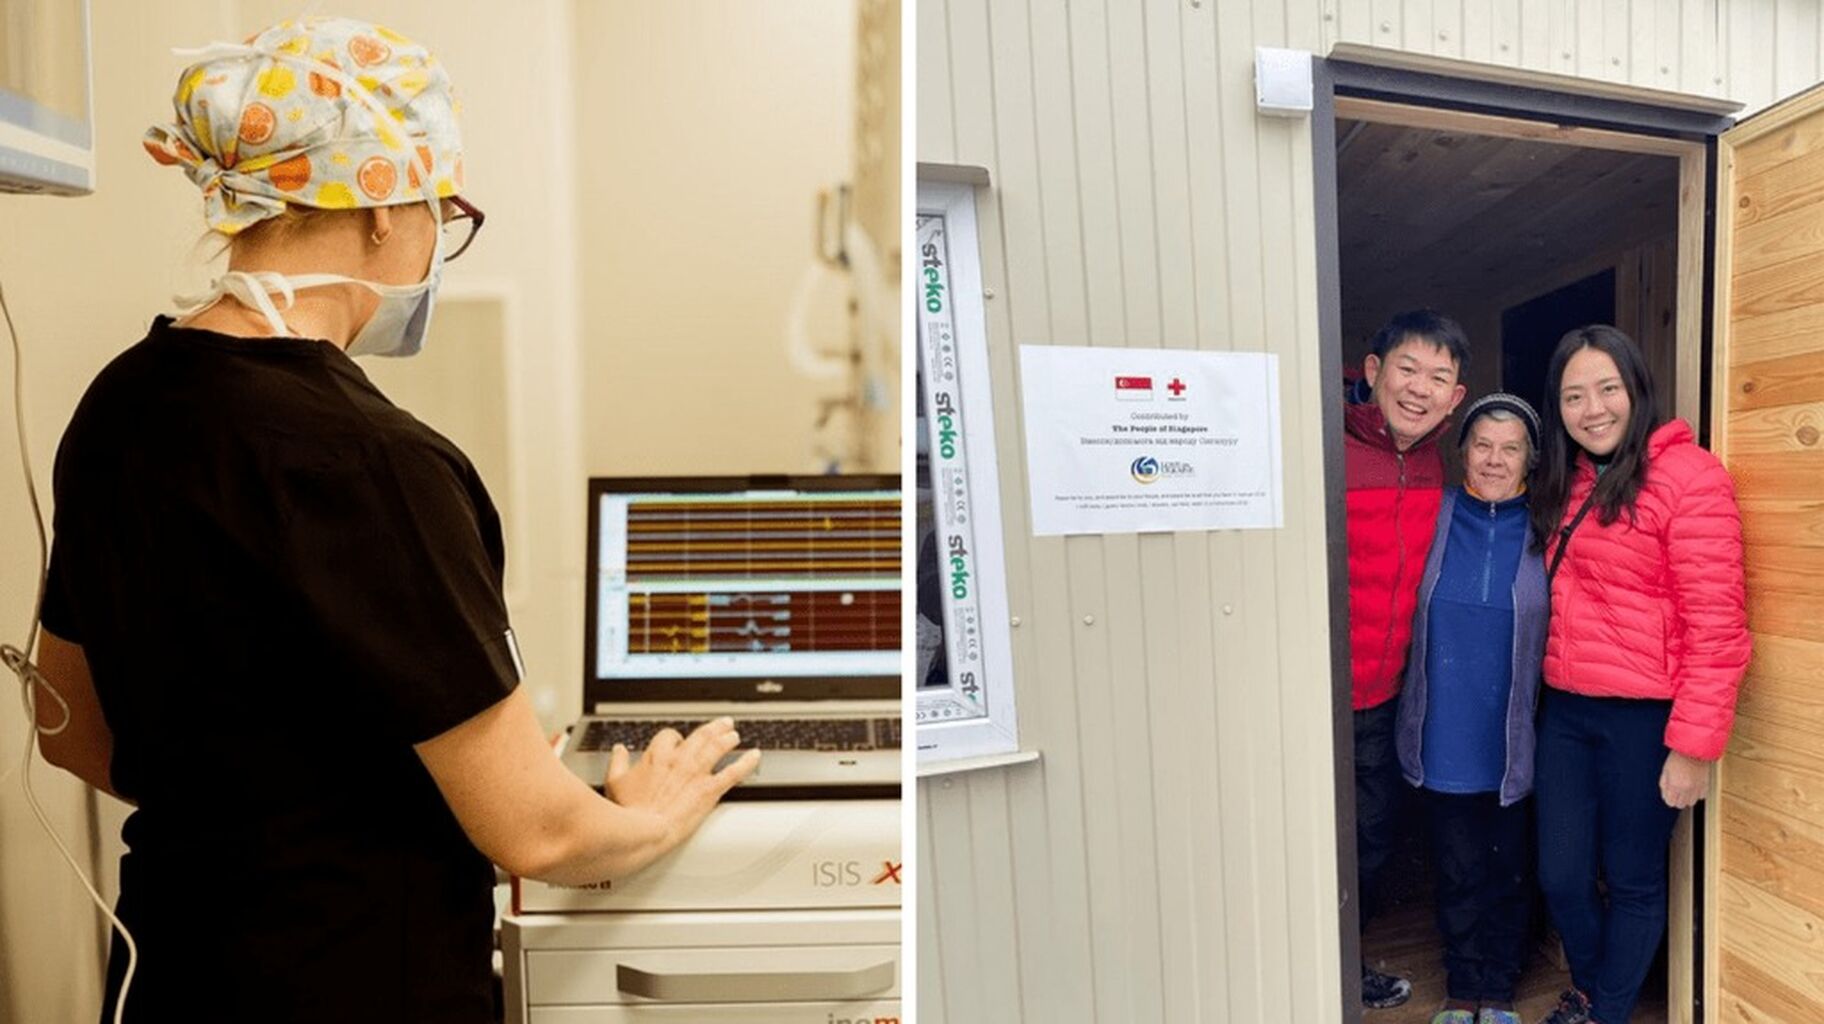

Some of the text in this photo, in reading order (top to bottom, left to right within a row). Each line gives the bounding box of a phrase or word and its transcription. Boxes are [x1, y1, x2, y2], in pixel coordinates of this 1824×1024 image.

[922, 243, 944, 313] steko
[935, 391, 958, 460] steko
[1112, 425, 1208, 434] The People of Singapore
[948, 534, 971, 600] steko
[813, 861, 861, 887] ISIS
